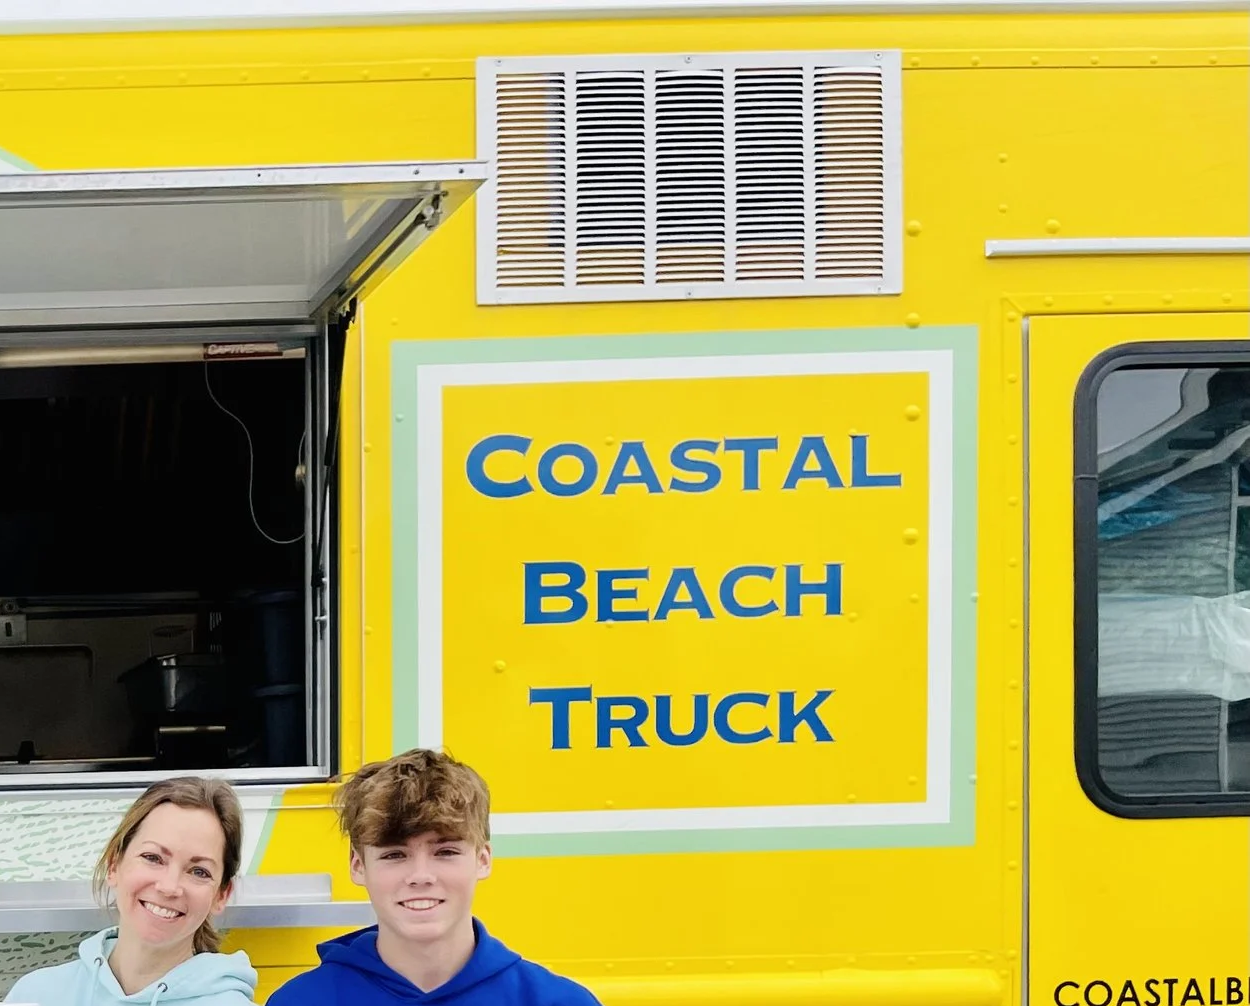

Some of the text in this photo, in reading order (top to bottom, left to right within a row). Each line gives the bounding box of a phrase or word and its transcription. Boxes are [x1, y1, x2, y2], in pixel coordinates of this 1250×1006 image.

[466, 435, 902, 498] COASTAL
[522, 562, 842, 625] BEACH
[528, 687, 836, 750] TRUCK
